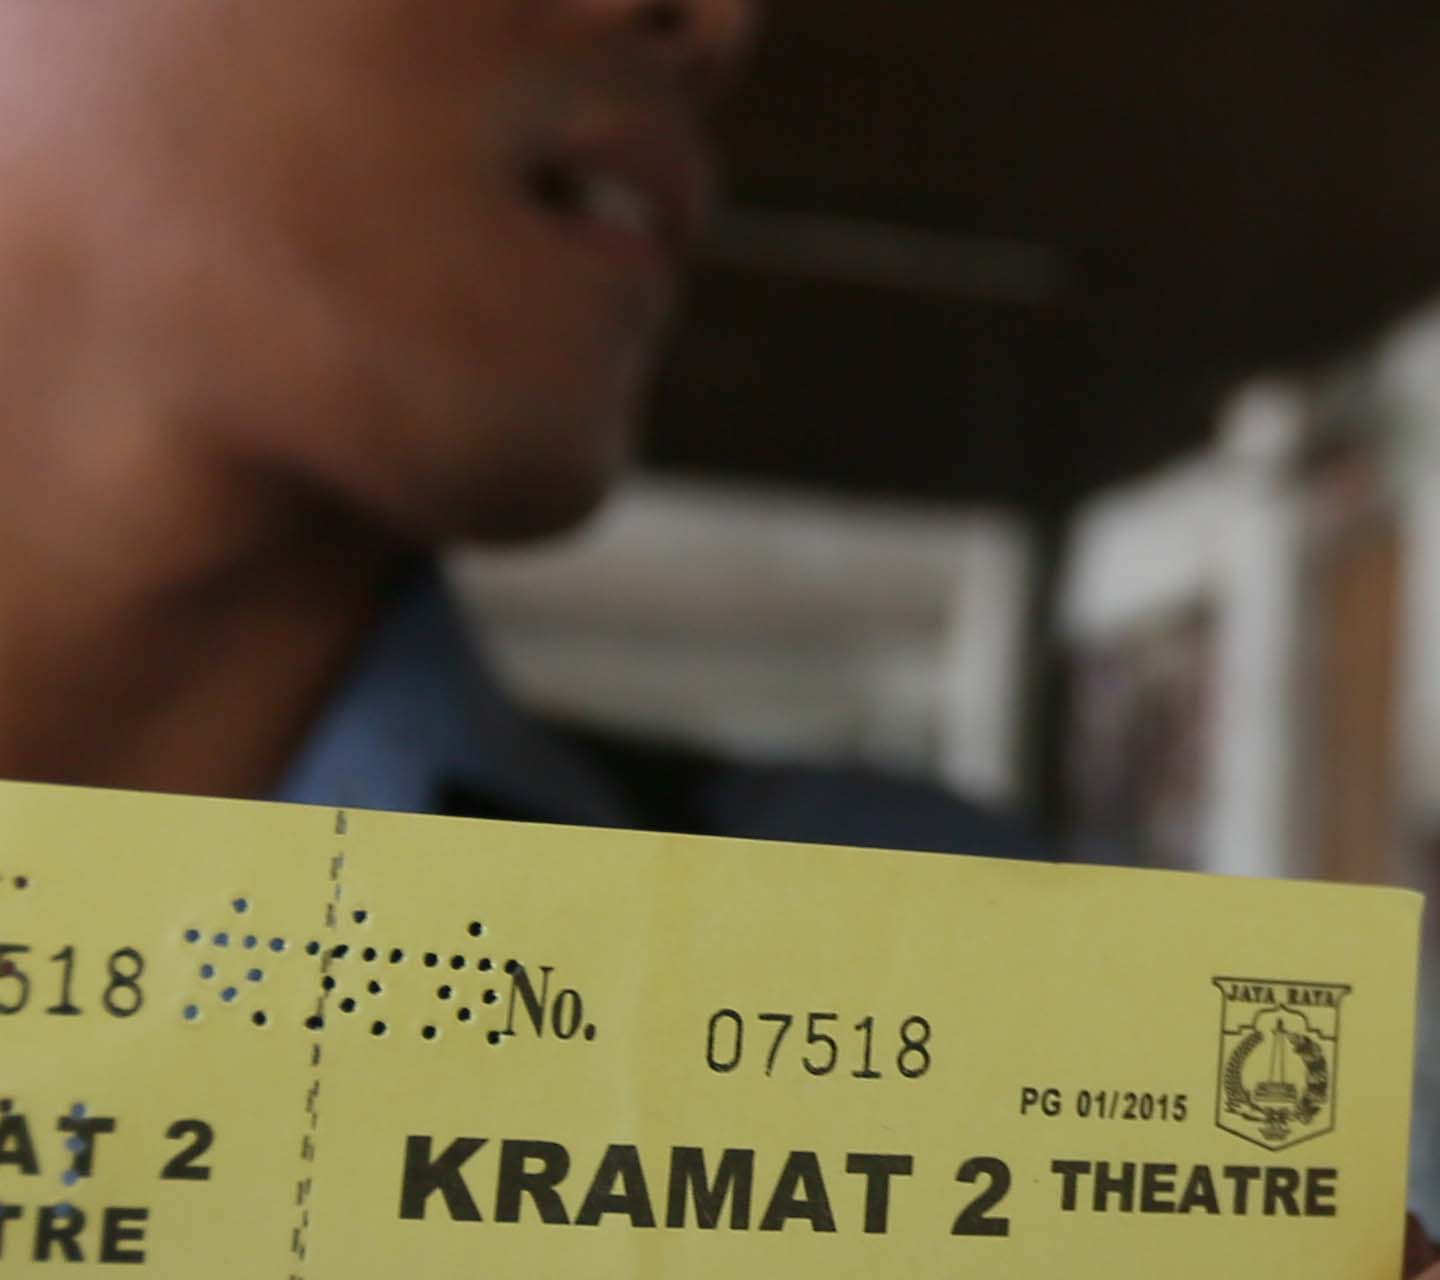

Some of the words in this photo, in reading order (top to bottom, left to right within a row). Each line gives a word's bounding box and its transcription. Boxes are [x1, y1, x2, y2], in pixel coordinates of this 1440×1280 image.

[502, 966, 597, 1042] No.
[704, 1007, 932, 1081] 07518
[1226, 982, 1276, 1005] JAYA
[1019, 1085, 1063, 1118] PG
[1075, 1088, 1189, 1124] 01/2015
[158, 1117, 216, 1182] 2
[397, 1133, 915, 1236] KRAMAT
[949, 1155, 1013, 1239] 2
[1049, 1158, 1340, 1219] THEATRE
